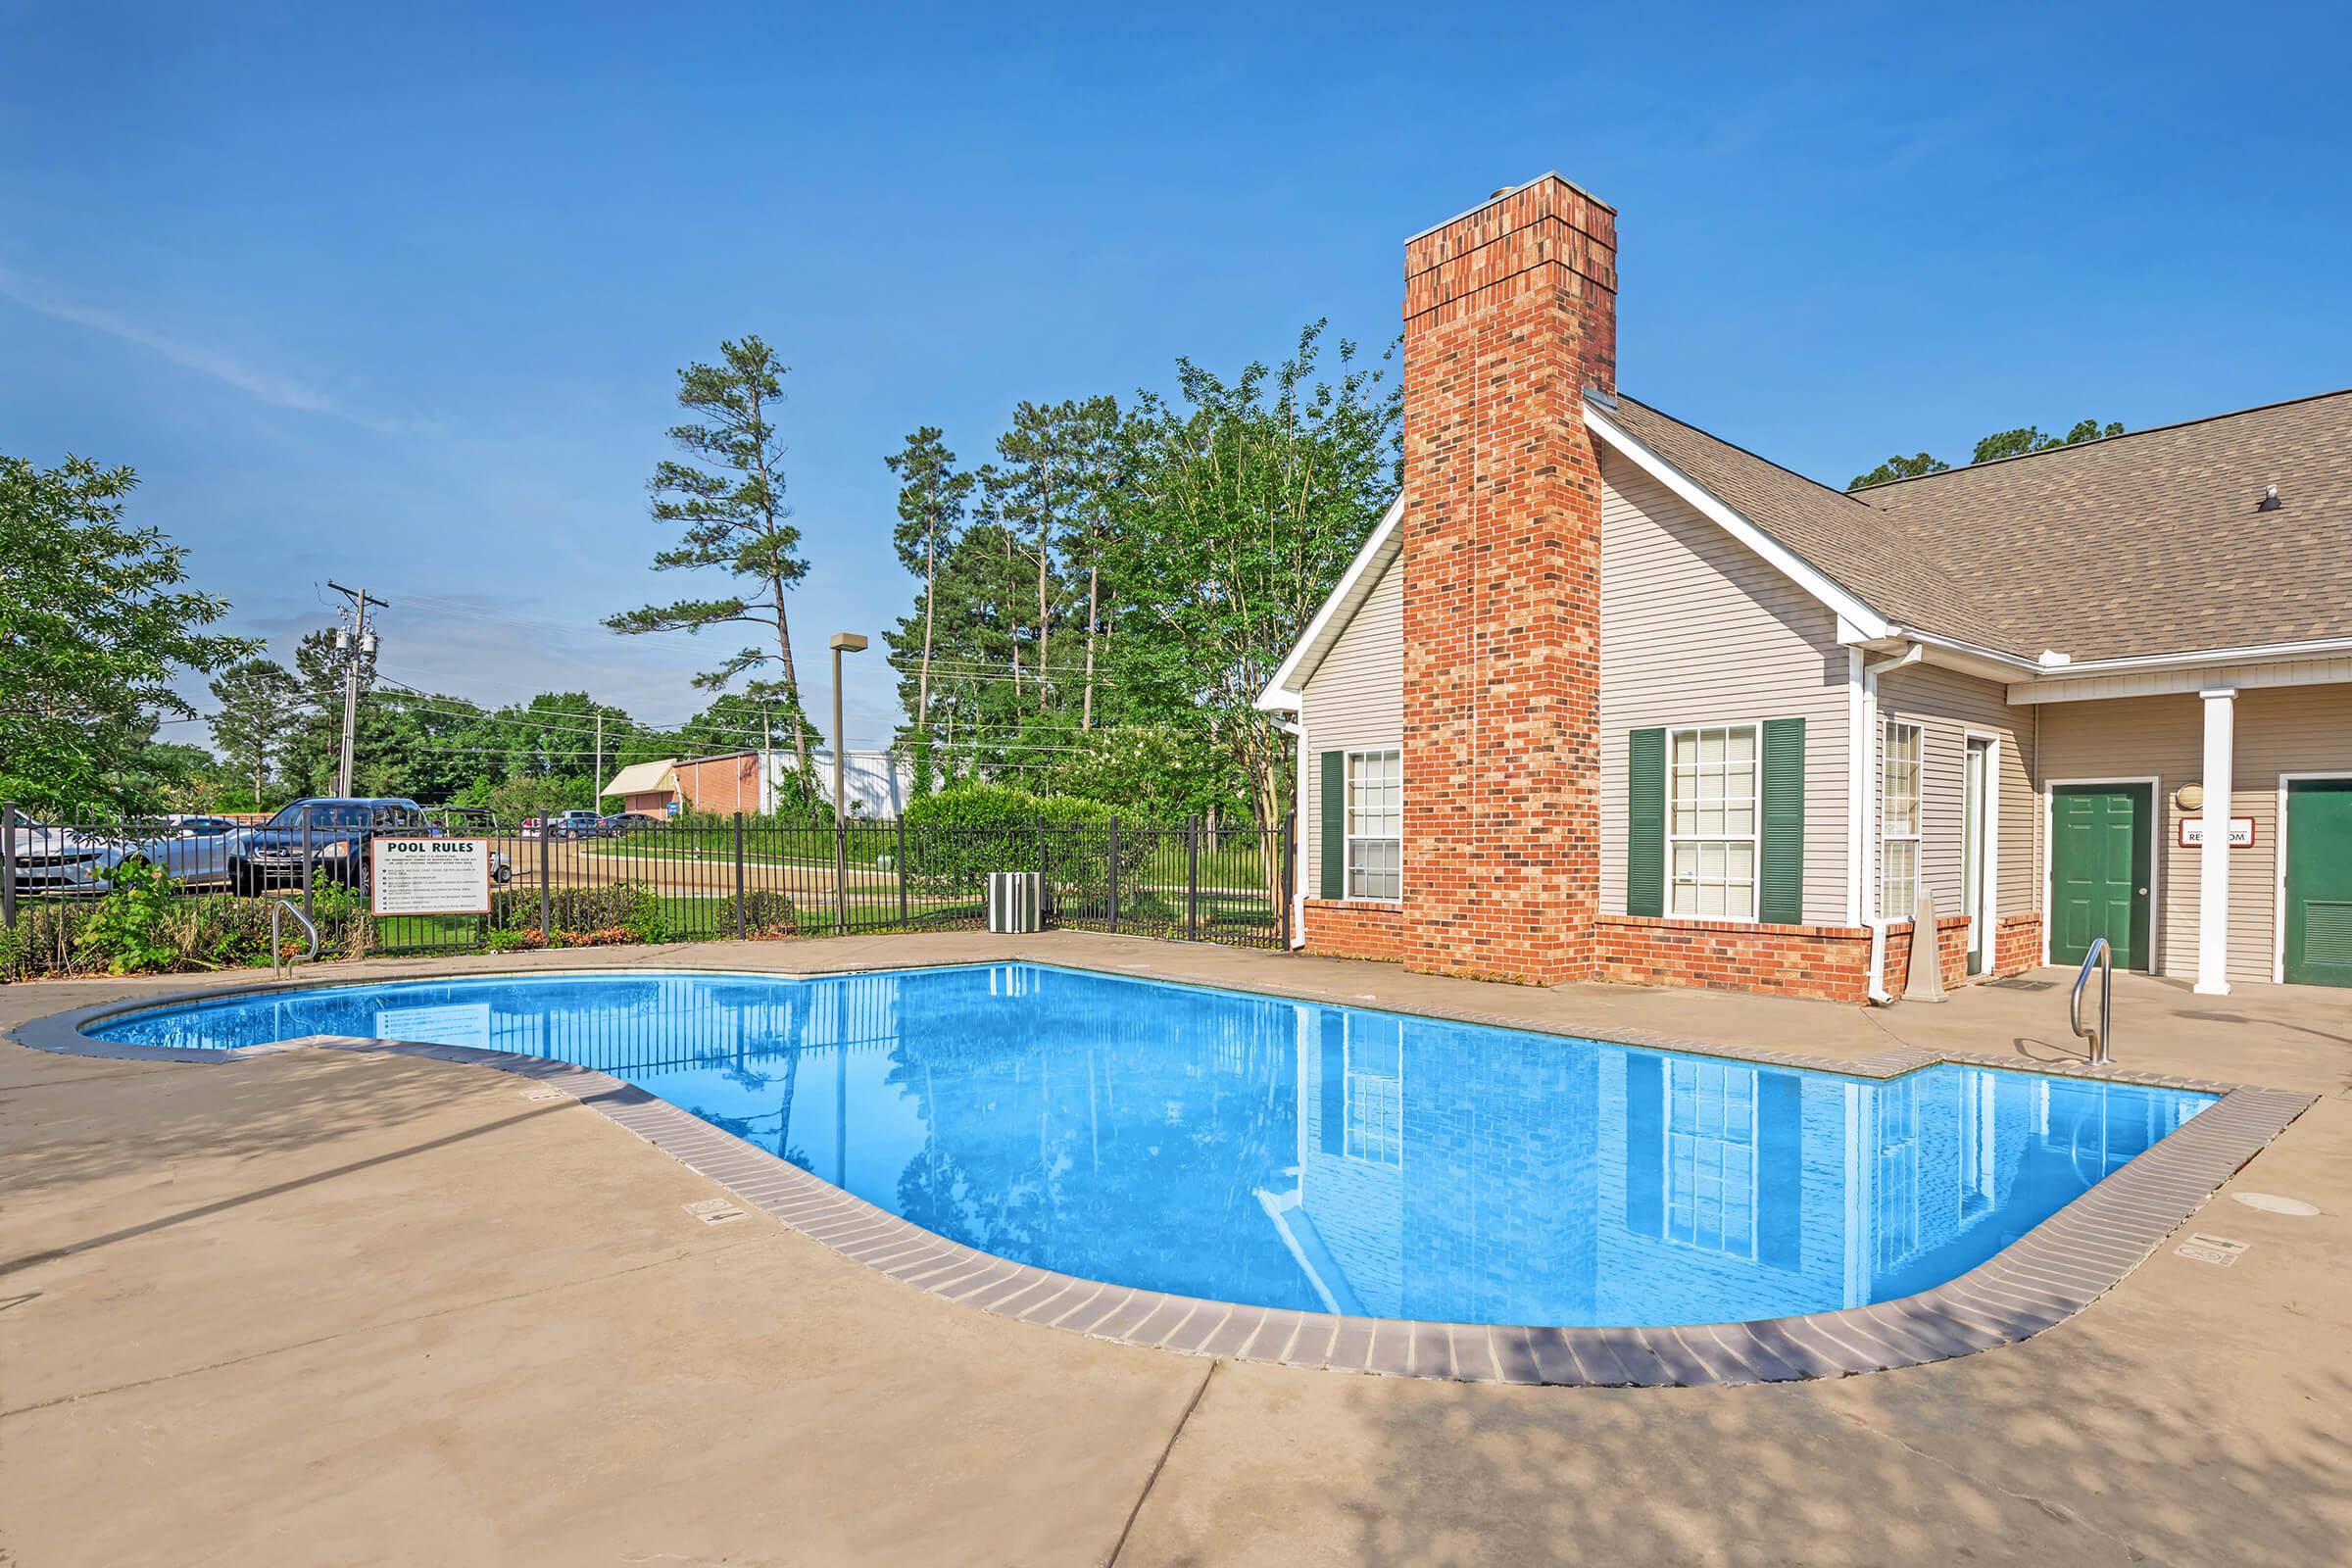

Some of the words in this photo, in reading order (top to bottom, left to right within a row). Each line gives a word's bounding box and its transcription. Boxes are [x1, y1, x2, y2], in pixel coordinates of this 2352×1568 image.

[2188, 833, 2246, 842] REOM
[387, 842, 426, 853] POOL
[432, 842, 473, 853] RULES
